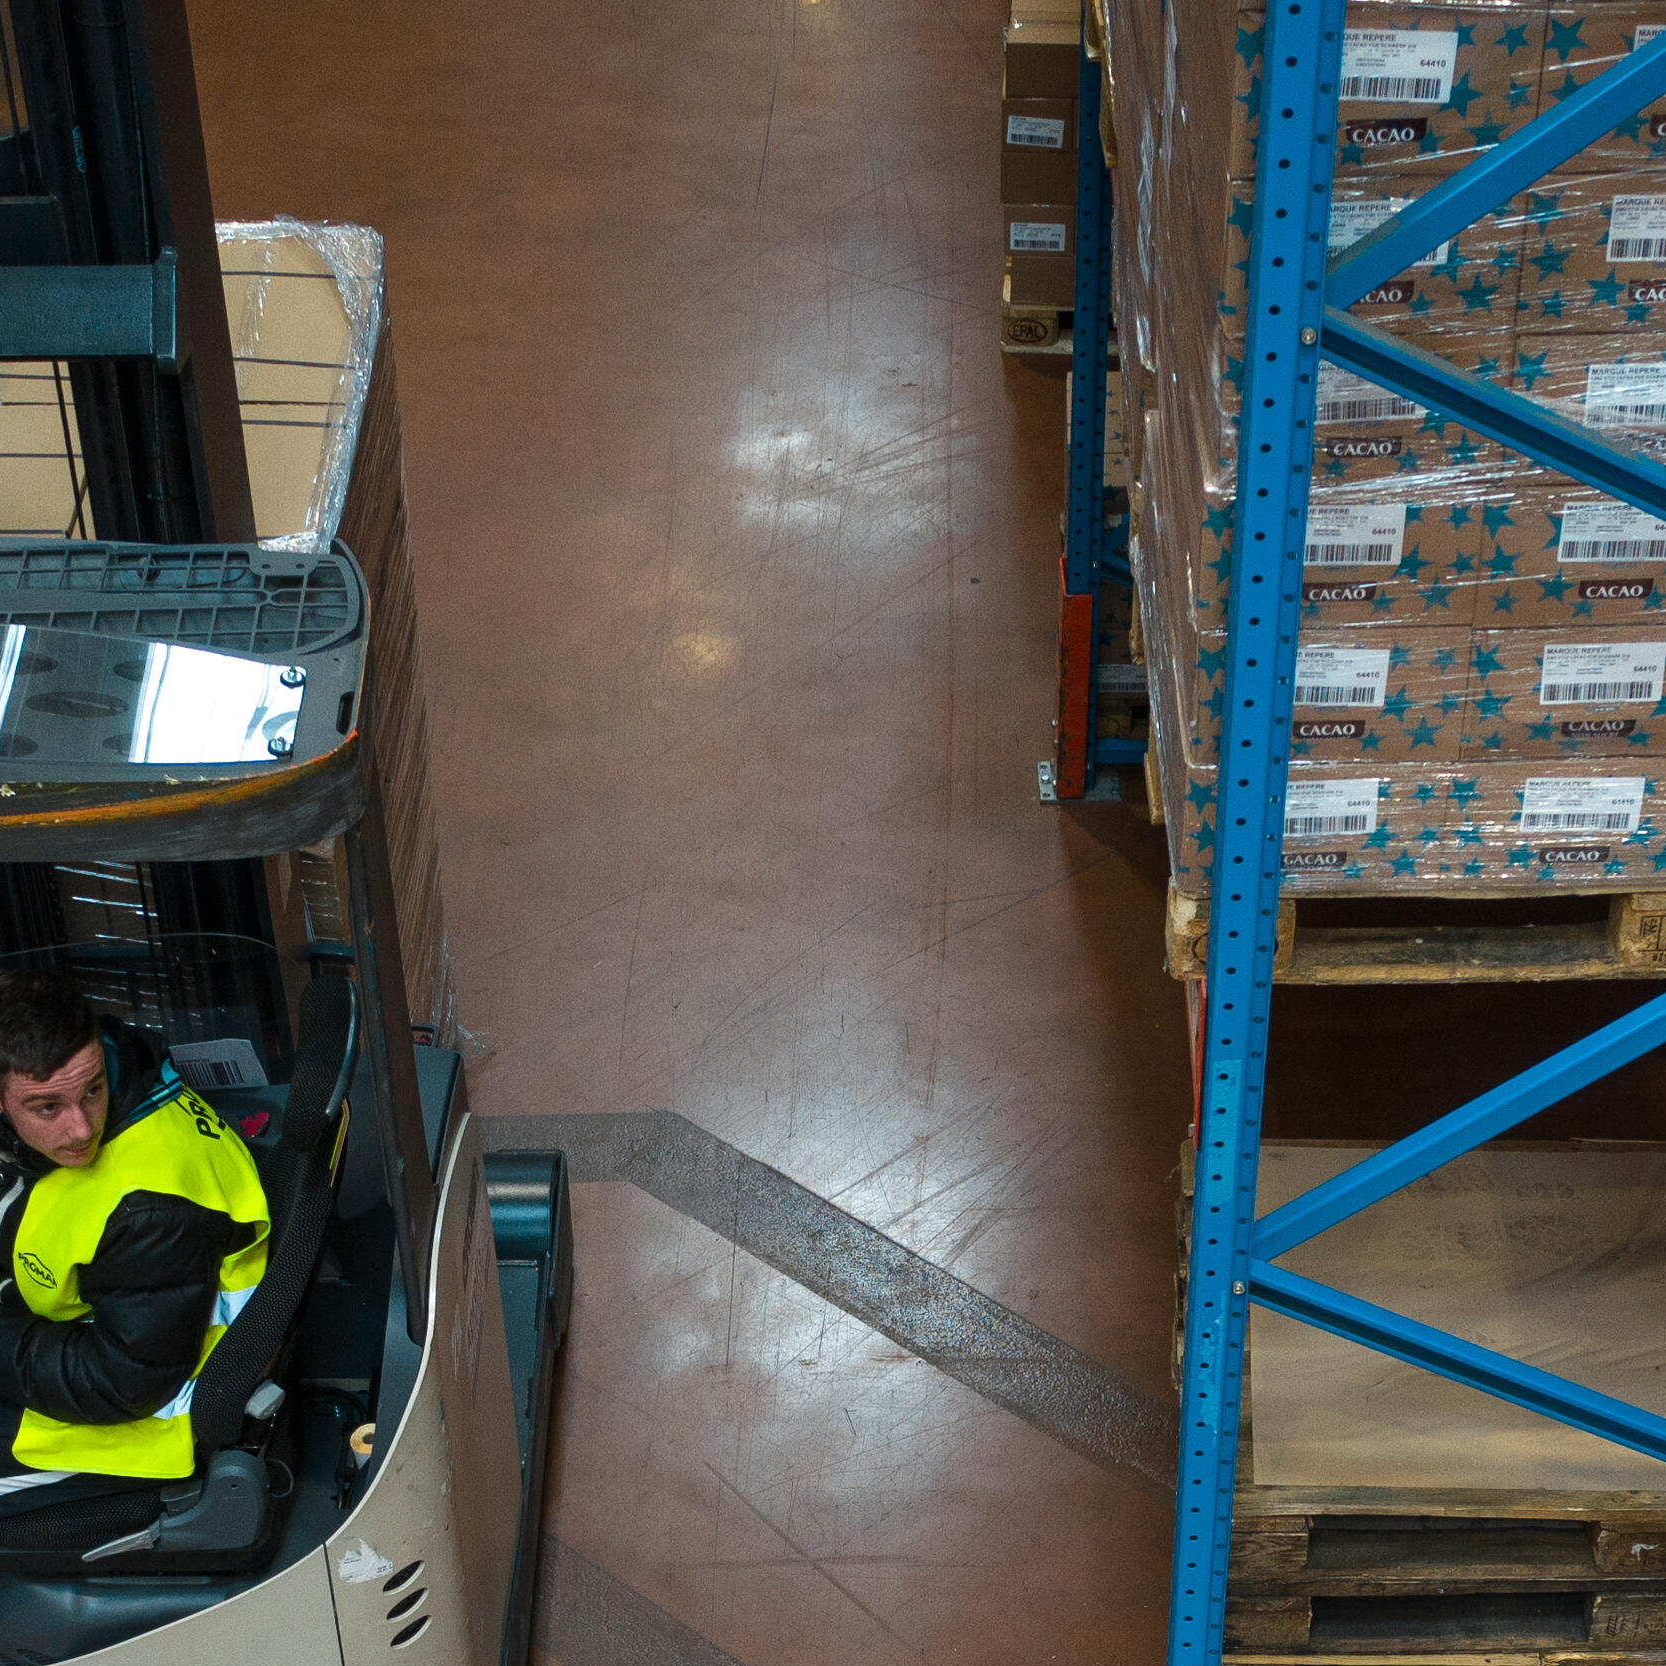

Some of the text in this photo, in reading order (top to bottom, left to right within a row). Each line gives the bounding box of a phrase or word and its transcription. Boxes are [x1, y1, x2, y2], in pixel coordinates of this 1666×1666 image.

[1352, 127, 1415, 144] CACAO
[1360, 288, 1403, 303] CAO
[1333, 442, 1393, 457] CACAO
[1308, 587, 1367, 601] CACAO
[1586, 585, 1644, 598] CACAO
[1299, 723, 1356, 737] CACAO
[1568, 720, 1625, 732] CACAO
[1283, 853, 1338, 866] CACAO
[1545, 850, 1600, 862] CACAO
